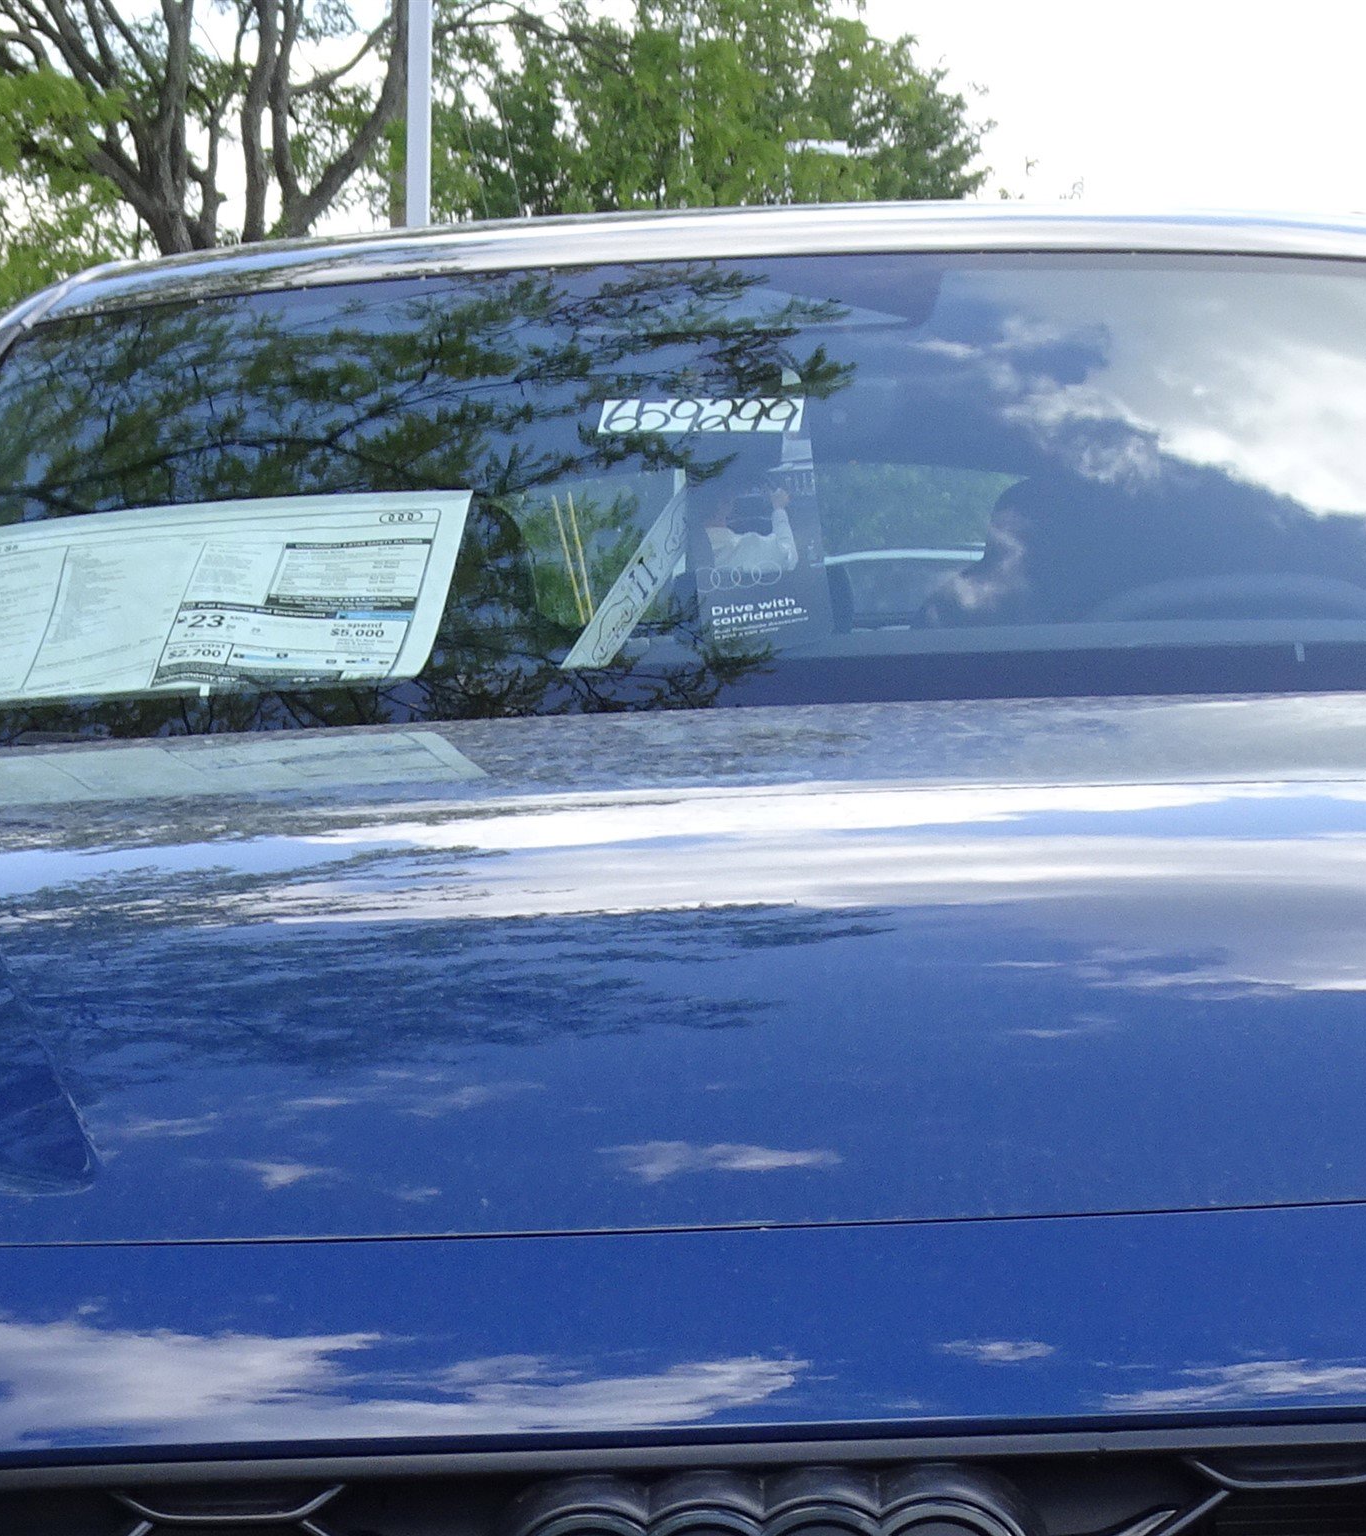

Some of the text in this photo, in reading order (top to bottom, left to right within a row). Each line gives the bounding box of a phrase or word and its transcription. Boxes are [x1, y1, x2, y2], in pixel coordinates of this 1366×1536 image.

[603, 399, 800, 432] 659299
[711, 597, 796, 616] Drive with
[273, 609, 326, 618] Environment
[712, 607, 808, 626] confidence.
[187, 614, 225, 628] 23
[347, 621, 383, 630] spend
[330, 628, 385, 638] $5,000
[168, 648, 221, 660] $2,700
